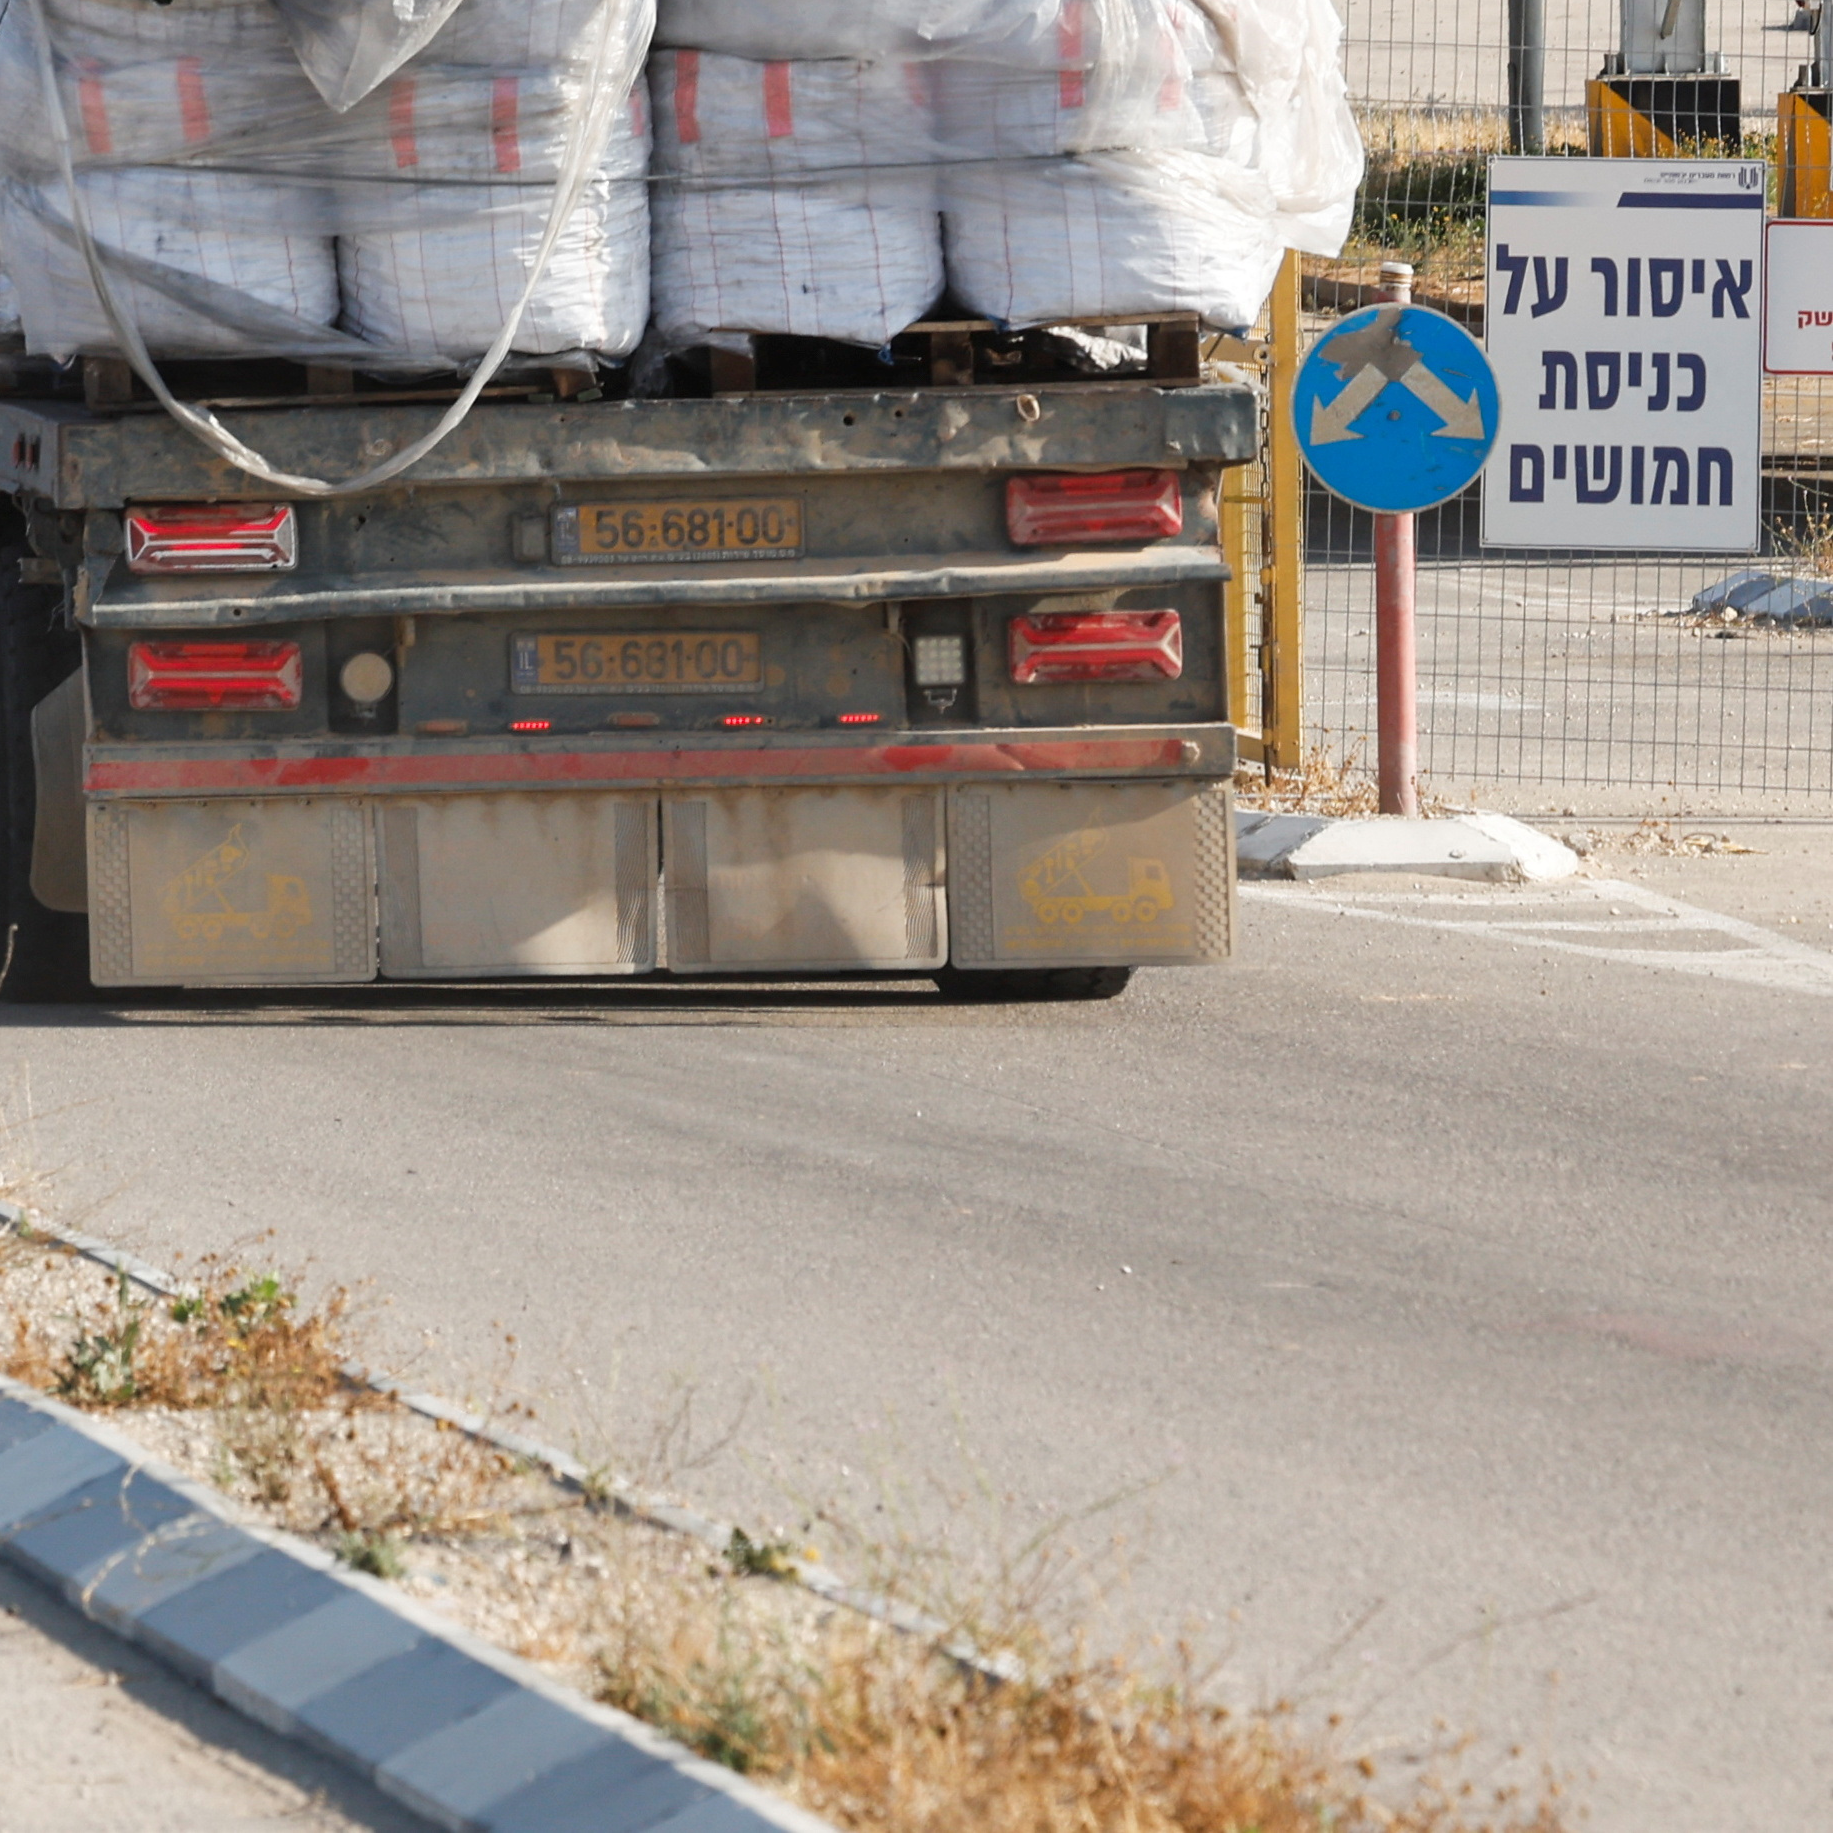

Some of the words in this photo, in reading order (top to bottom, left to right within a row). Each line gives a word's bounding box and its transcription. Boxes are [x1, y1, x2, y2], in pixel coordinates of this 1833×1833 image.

[1495, 243, 1570, 319] על
[1590, 254, 1753, 320] איסור
[1537, 349, 1708, 413] כניסת
[1508, 443, 1734, 508] חמושים
